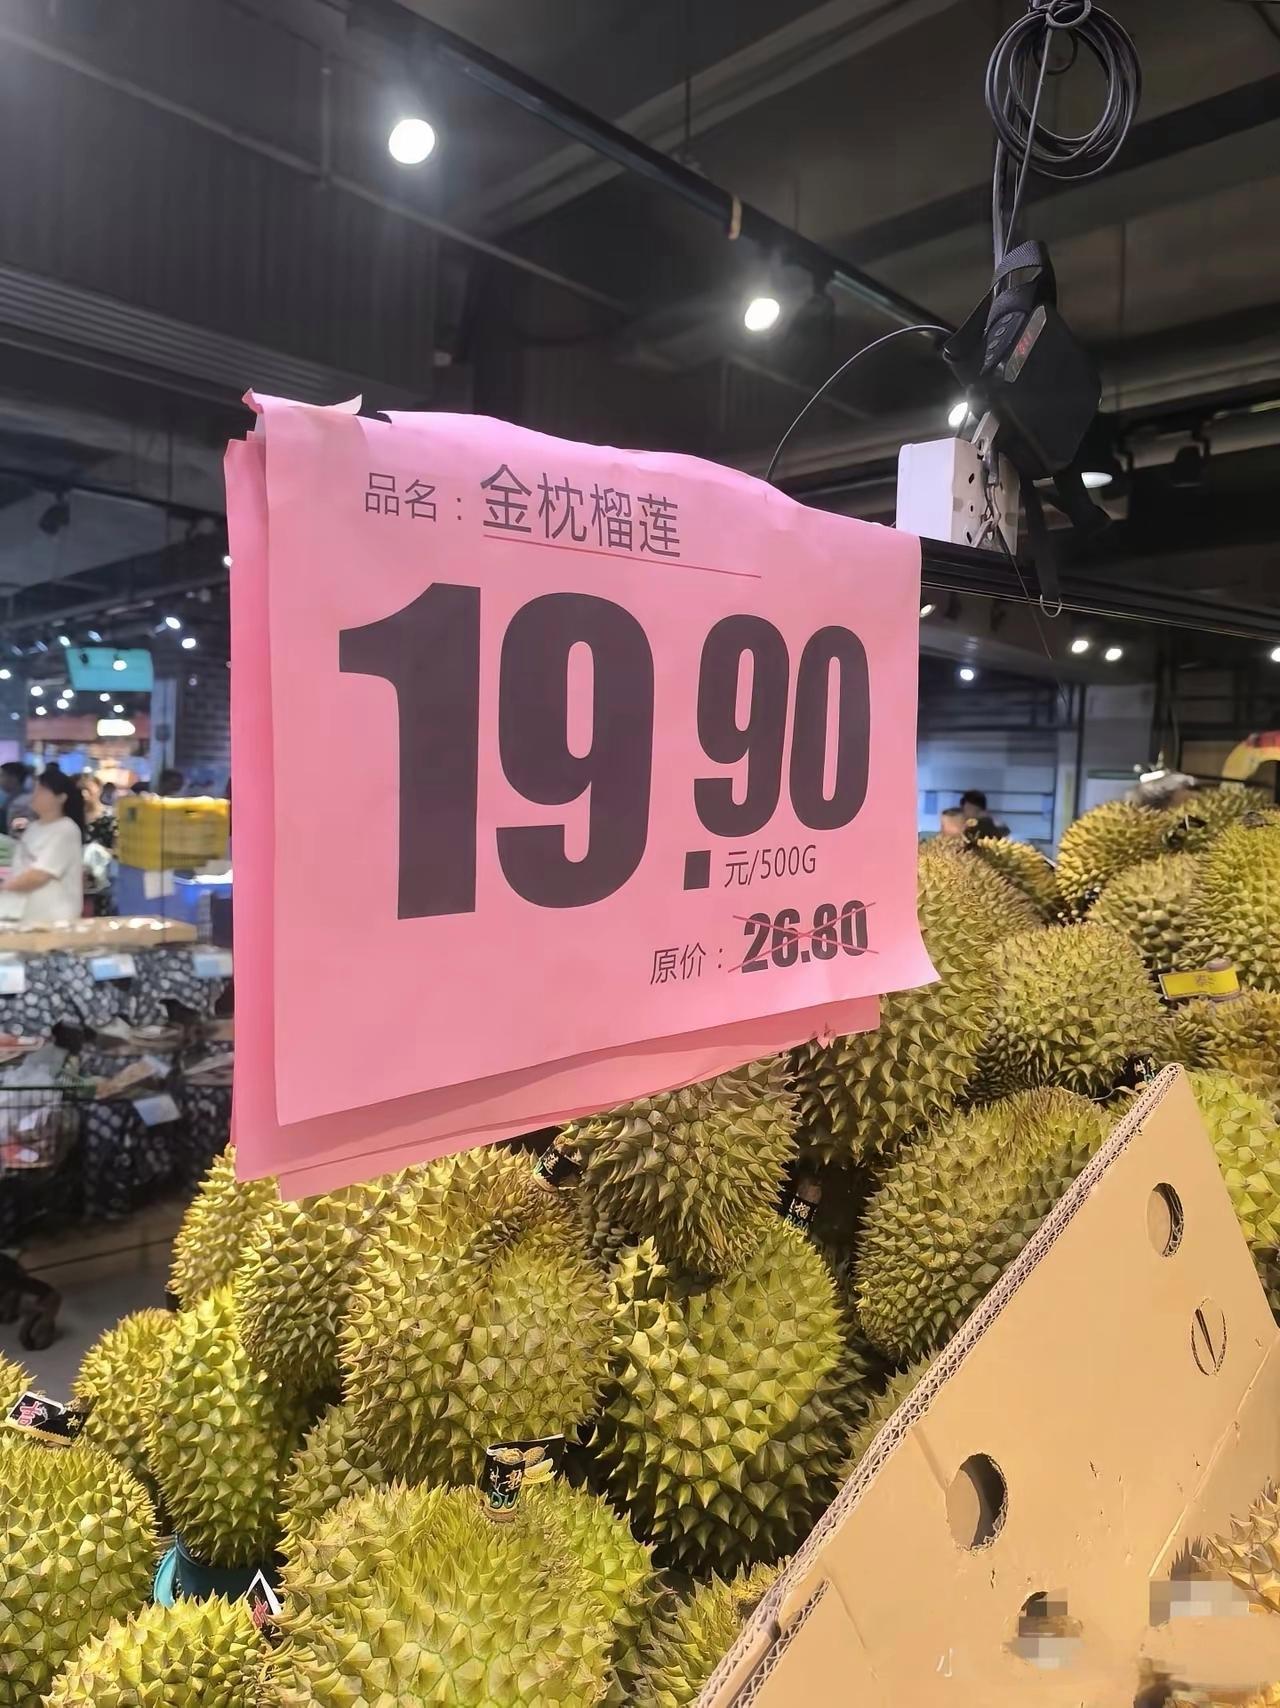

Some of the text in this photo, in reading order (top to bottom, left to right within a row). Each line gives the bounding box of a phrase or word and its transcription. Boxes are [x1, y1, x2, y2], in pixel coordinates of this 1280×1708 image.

[480, 463, 681, 558] 金枕榴莲
[338, 582, 871, 921] 19.90
[724, 844, 817, 888] 元/500G
[741, 899, 869, 974] 26.80
